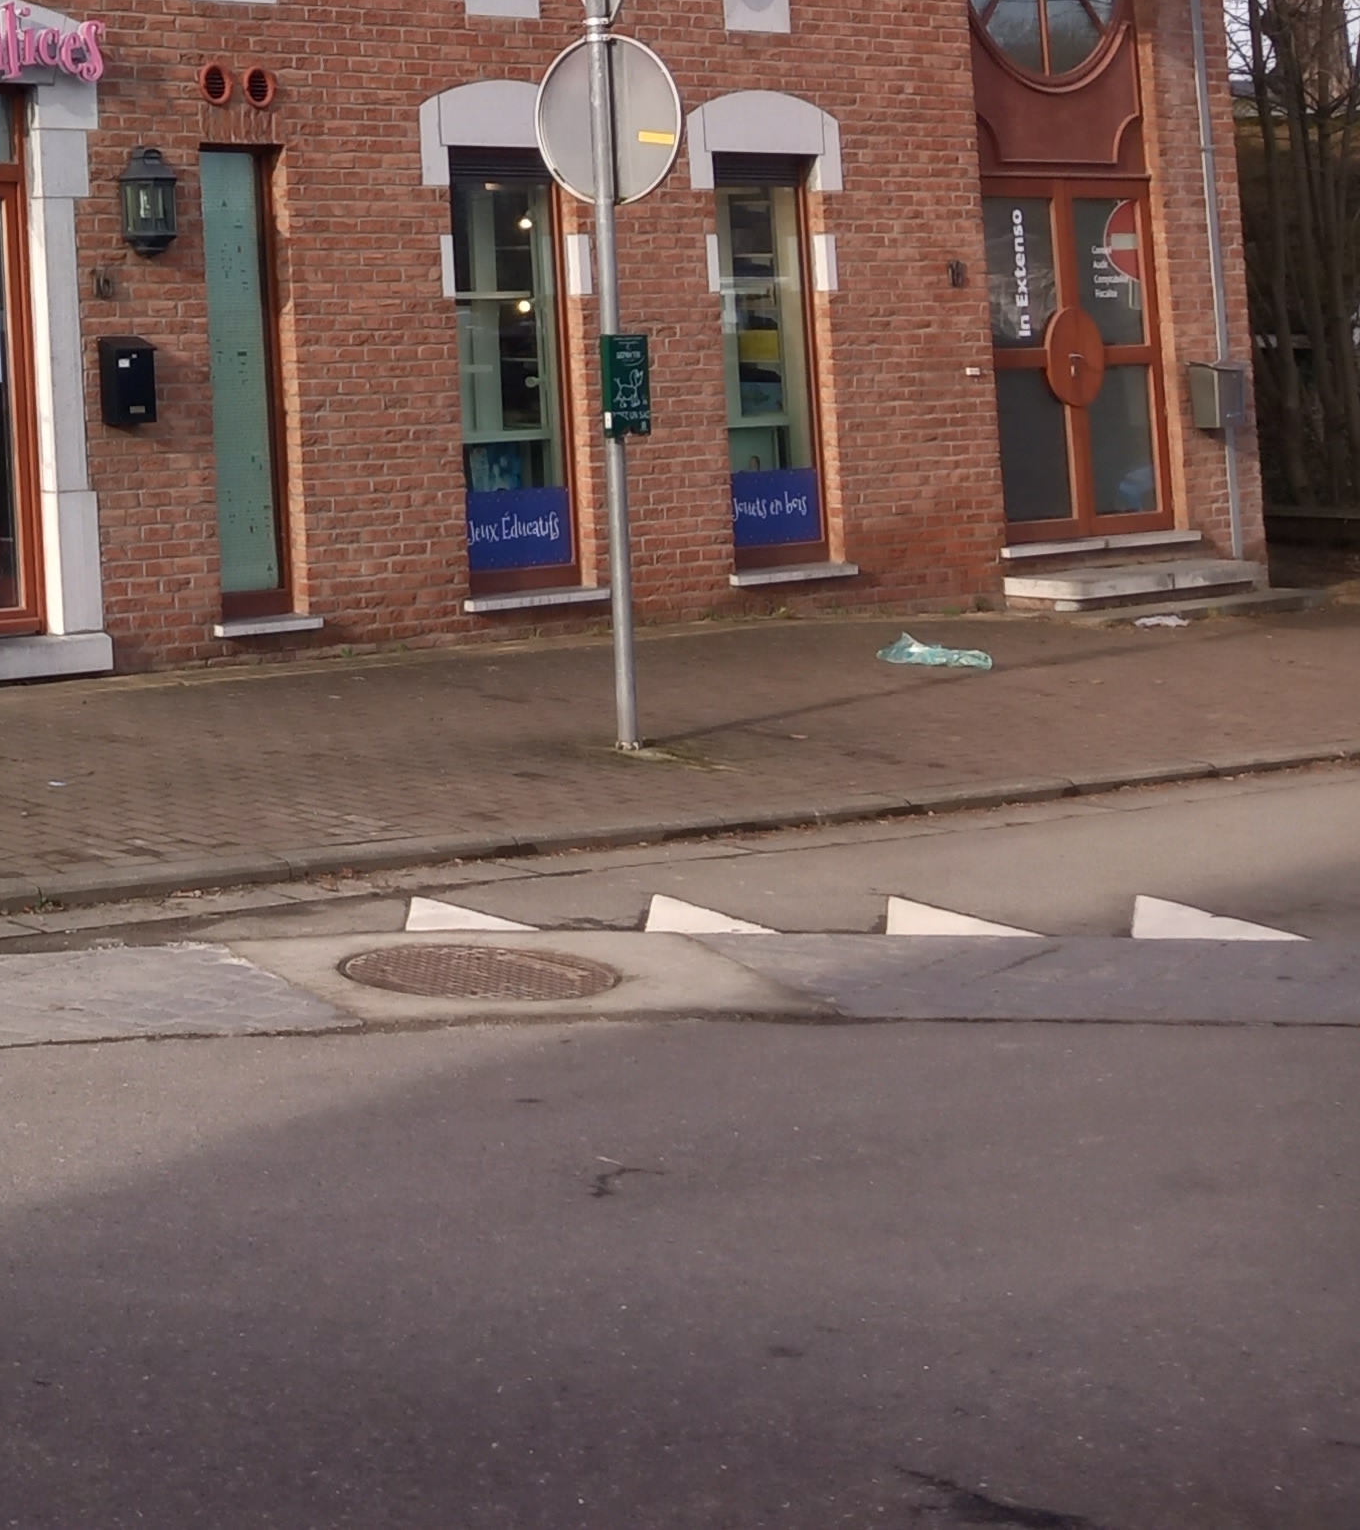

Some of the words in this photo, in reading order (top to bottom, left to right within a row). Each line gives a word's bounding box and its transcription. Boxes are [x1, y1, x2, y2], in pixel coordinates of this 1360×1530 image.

[1012, 209, 1029, 307] Extenso
[1019, 314, 1031, 337] In
[731, 497, 768, 522] Jouets
[769, 498, 783, 515] en
[784, 491, 807, 516] bois
[467, 520, 500, 545] Jeux
[501, 510, 560, 541] Éducatifs
